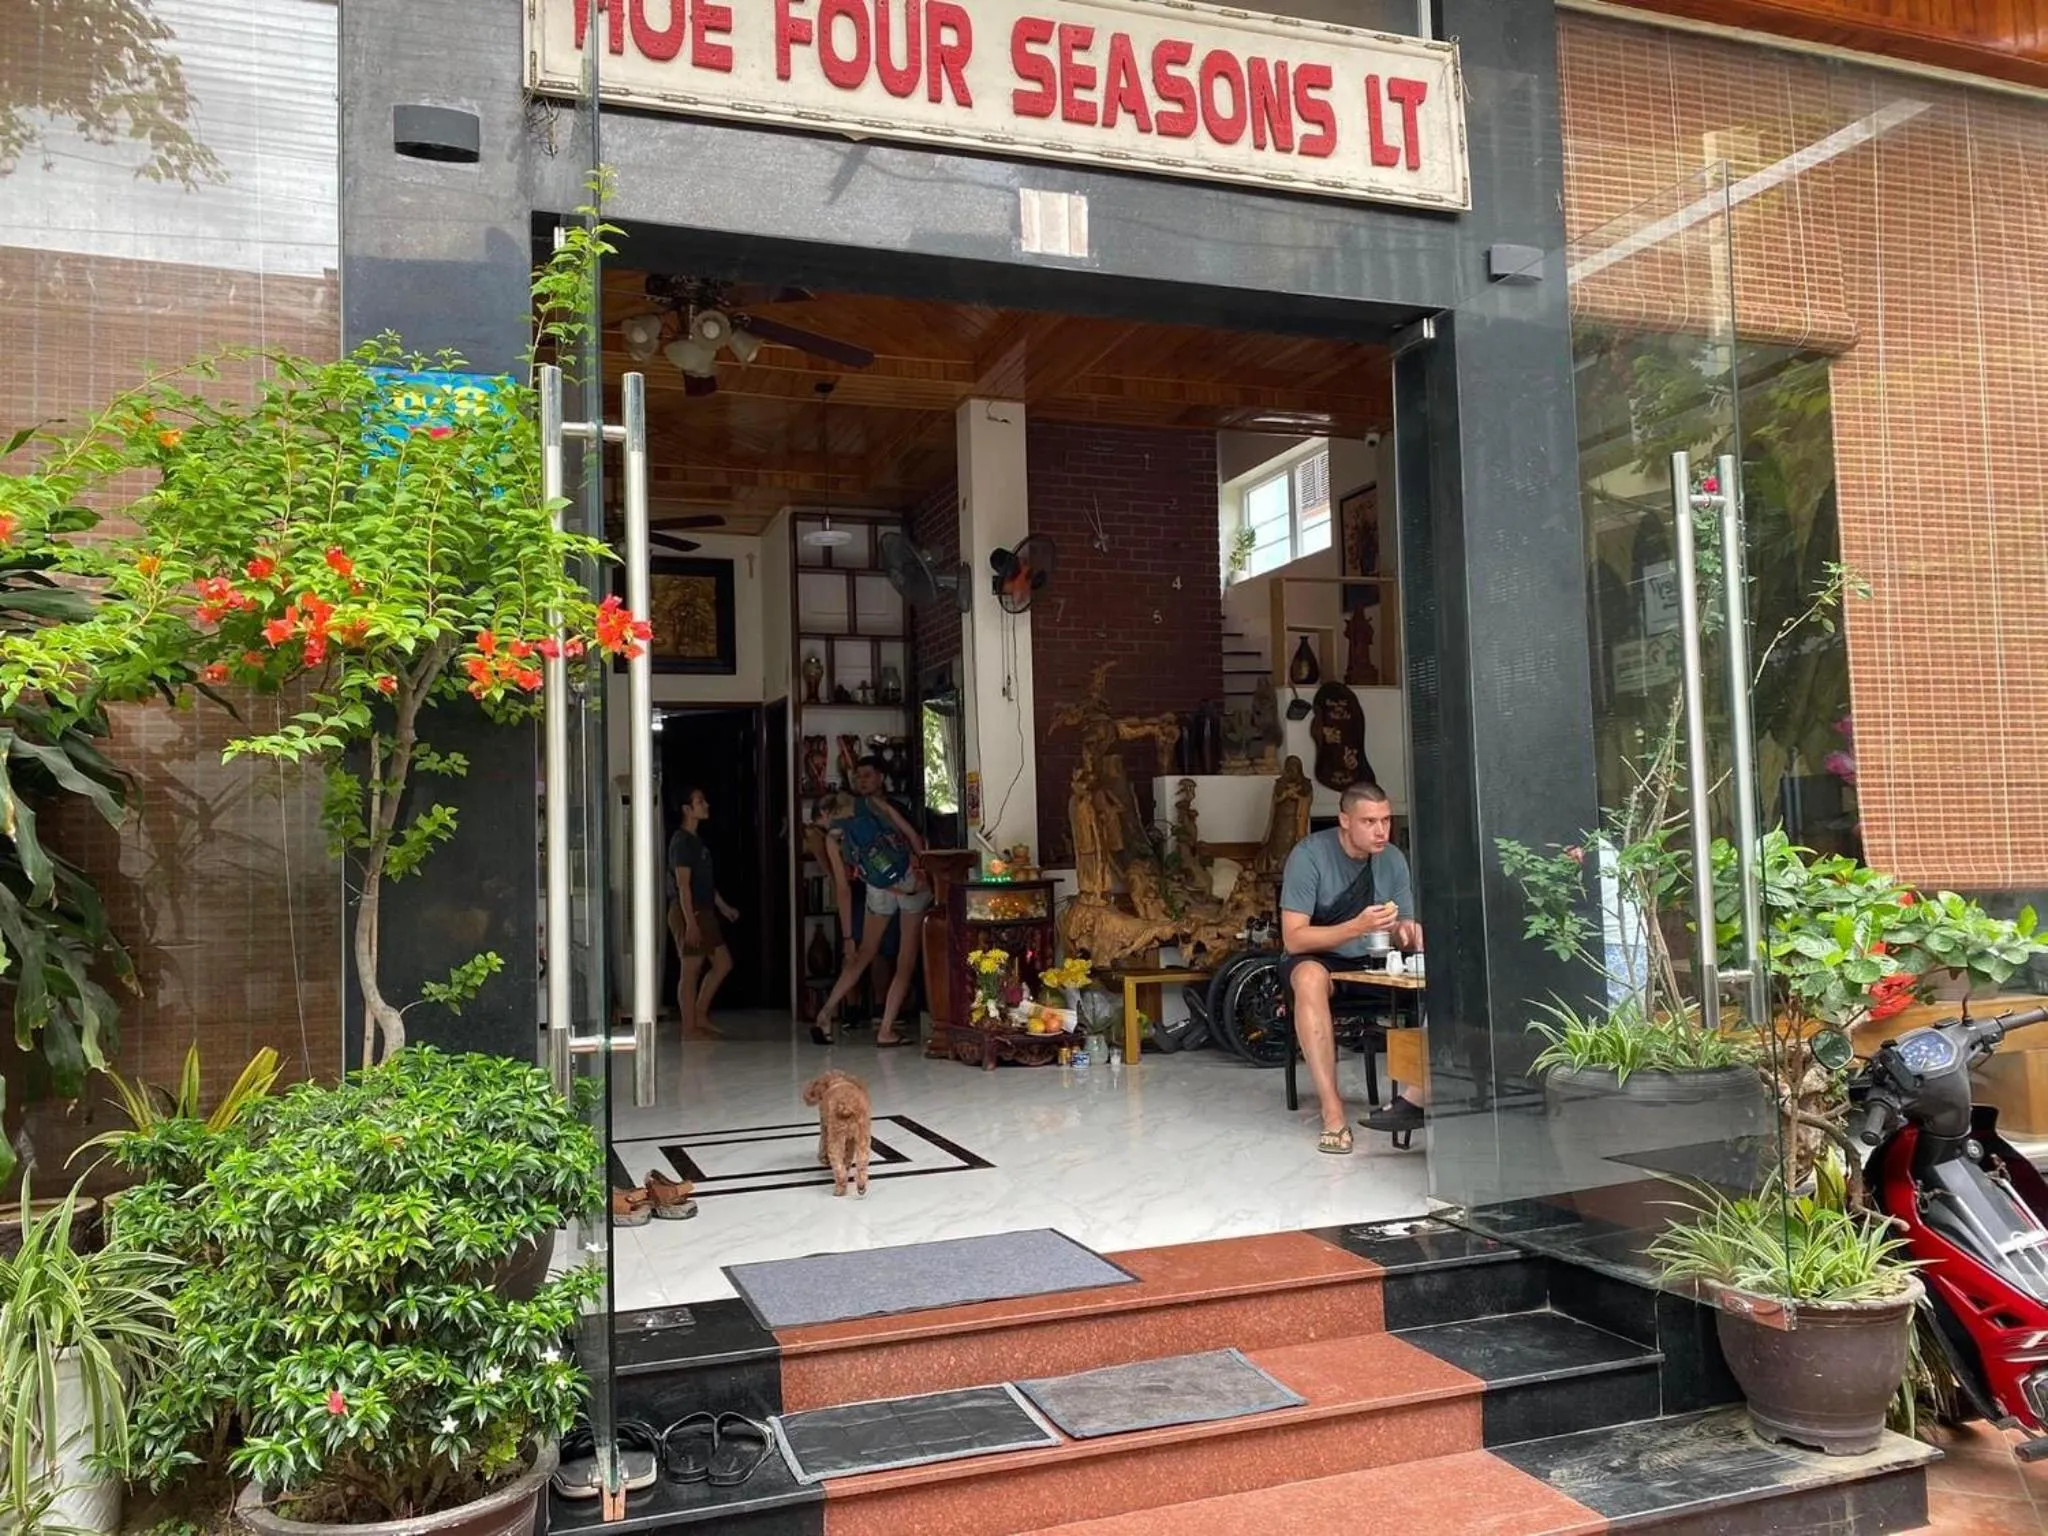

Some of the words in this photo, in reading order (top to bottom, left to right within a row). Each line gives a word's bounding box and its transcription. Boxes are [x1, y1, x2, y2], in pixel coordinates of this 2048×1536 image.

[774, 0, 974, 108] FOUR
[1010, 16, 1338, 158] SEASONS
[1365, 74, 1428, 171] LT
[1172, 575, 1184, 591] 4
